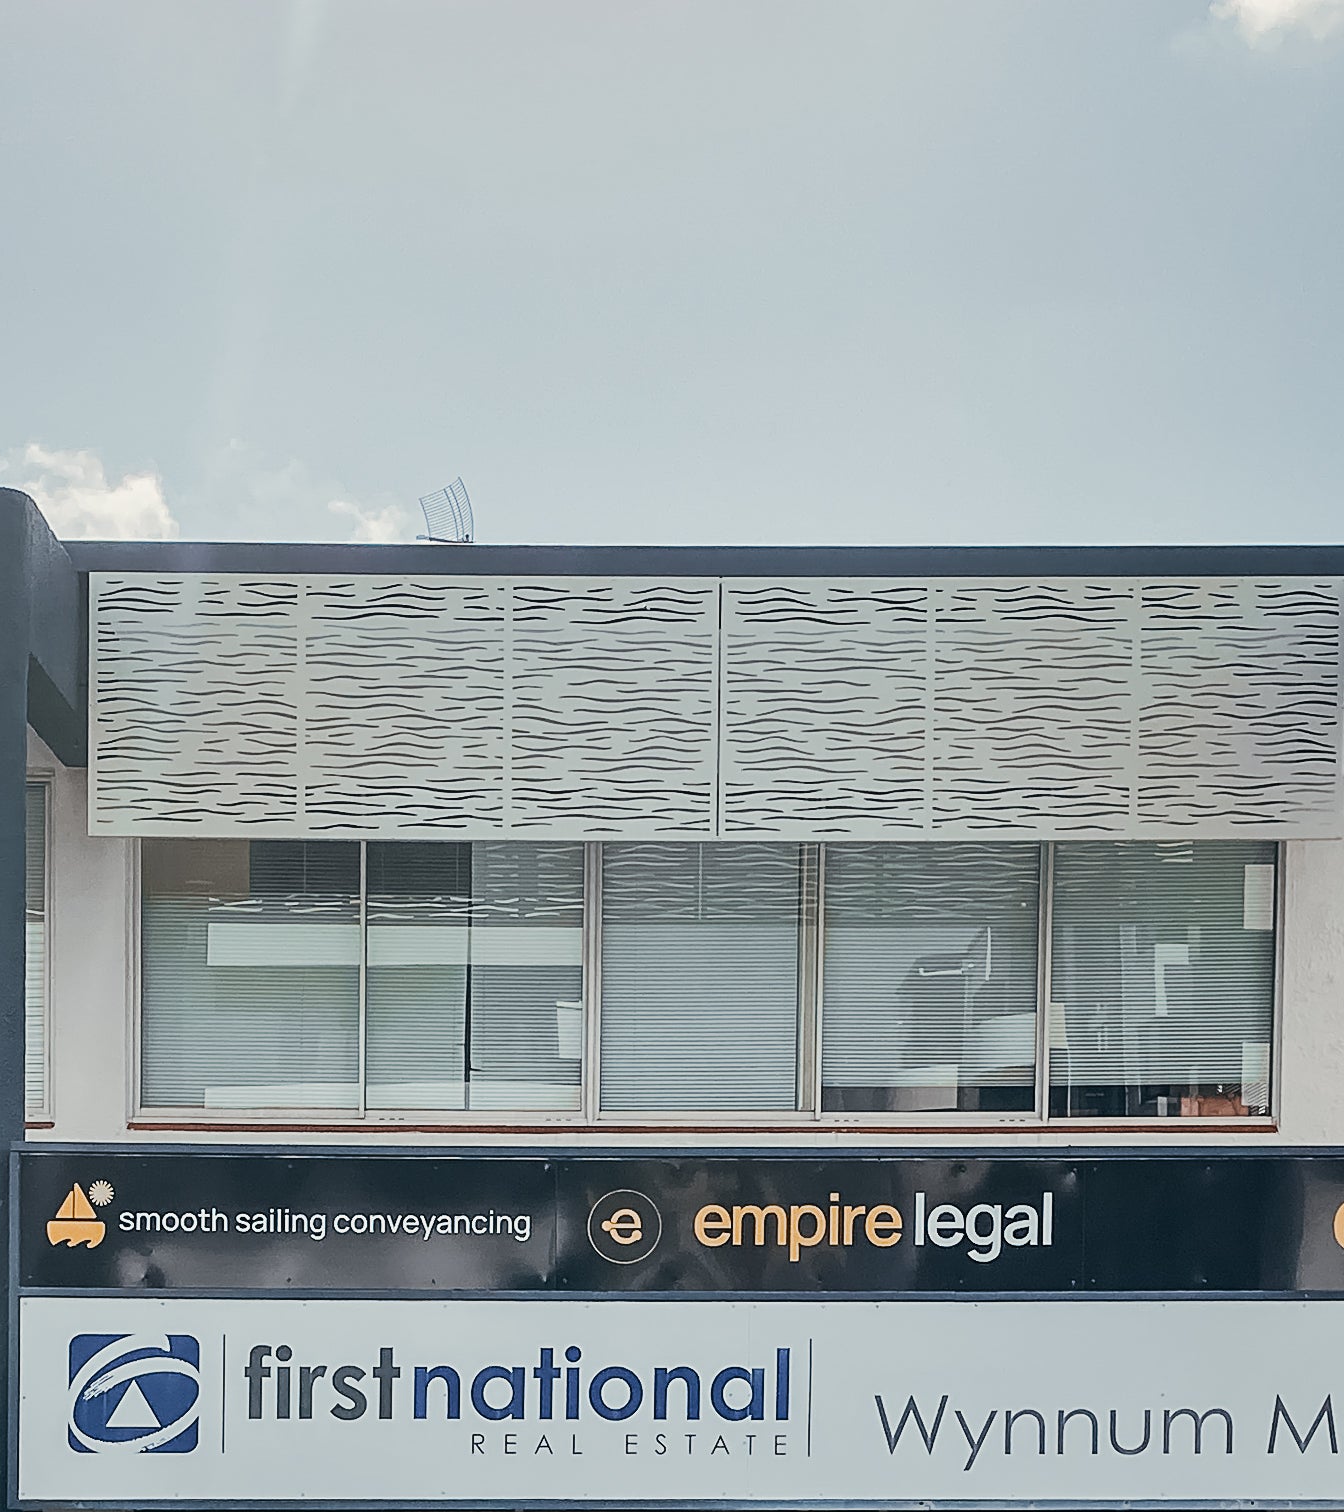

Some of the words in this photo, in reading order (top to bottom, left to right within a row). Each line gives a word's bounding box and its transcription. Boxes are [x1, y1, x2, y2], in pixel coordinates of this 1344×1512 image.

[118, 1207, 229, 1233] smooth
[235, 1207, 327, 1242] sailing
[333, 1208, 532, 1242] conveyancing
[693, 1192, 904, 1263] empire
[913, 1191, 1054, 1264] legal
[244, 1344, 791, 1421] firstnational
[471, 1433, 583, 1456] REAL
[624, 1433, 788, 1456] ESTATE
[873, 1394, 1234, 1472] Wynnum
